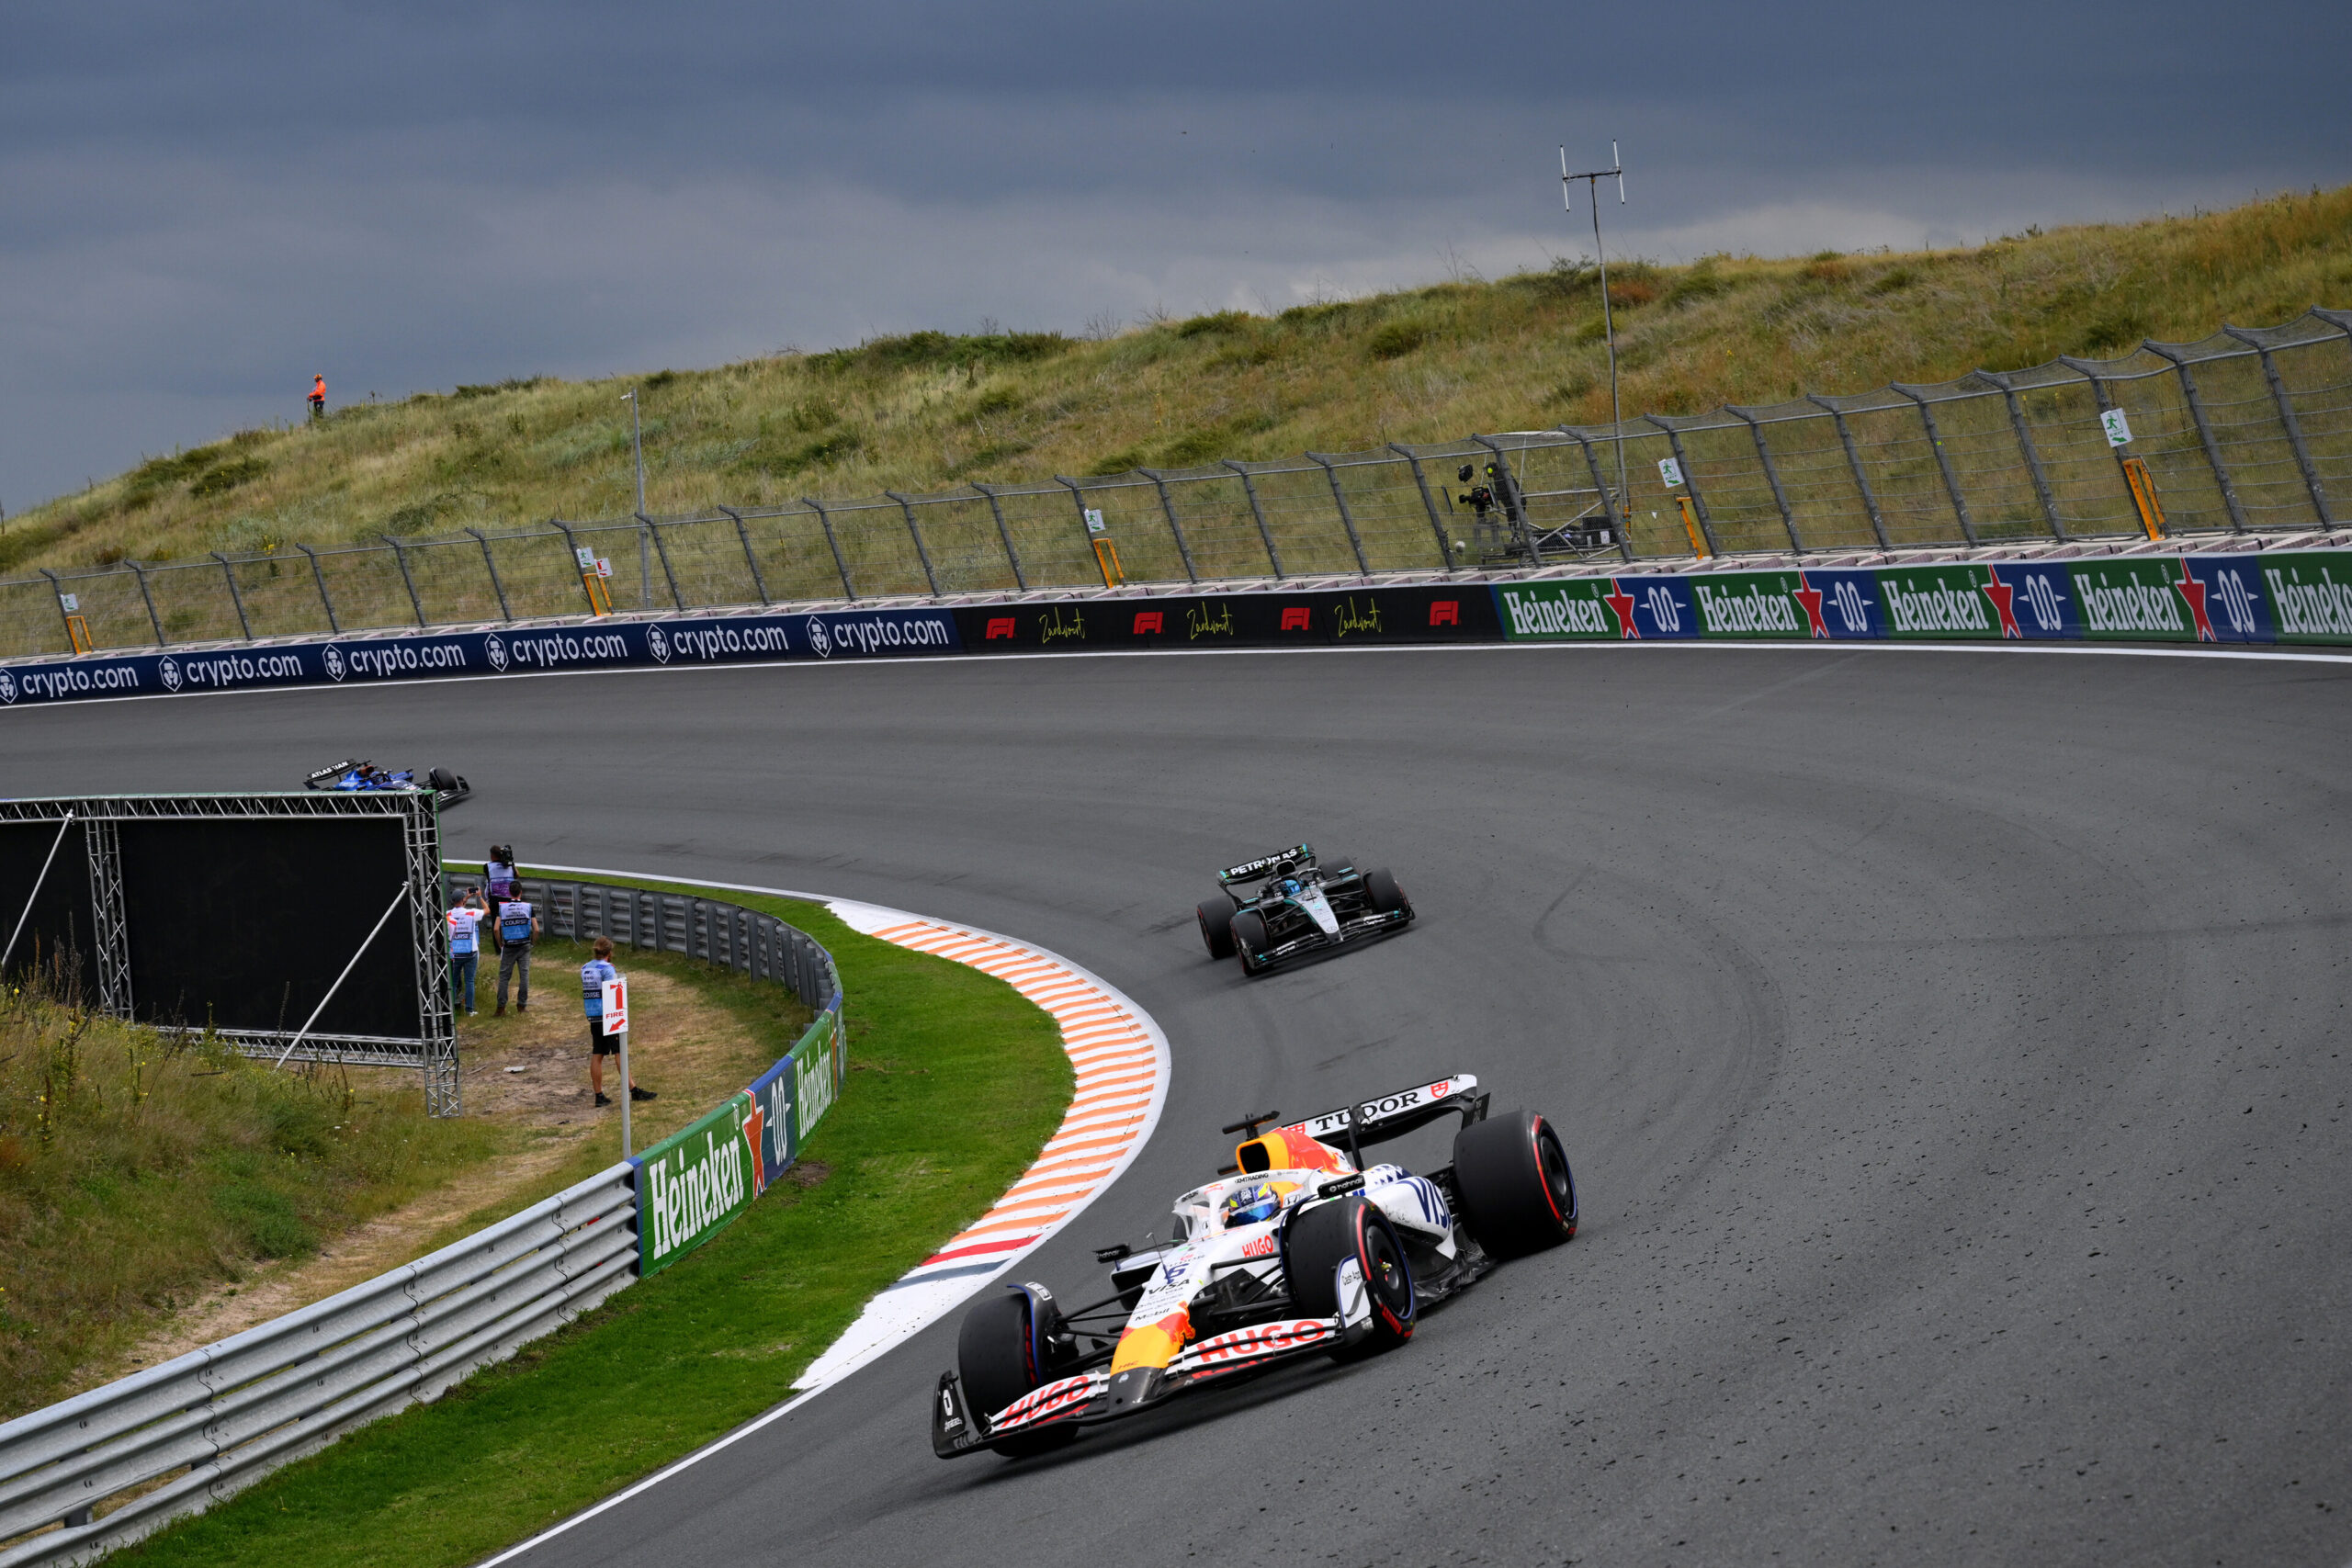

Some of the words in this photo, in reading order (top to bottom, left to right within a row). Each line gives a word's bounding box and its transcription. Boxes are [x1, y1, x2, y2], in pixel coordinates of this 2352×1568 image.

[986, 617, 1016, 639] F1
[1133, 612, 1164, 635] F1
[1281, 607, 1311, 630] F1
[1429, 601, 1459, 626] F1
[1504, 590, 1608, 634] Heineken
[1695, 584, 1798, 632] Heineken
[1882, 578, 1989, 631] Heineken
[2074, 572, 2184, 631] Heineken
[513, 633, 628, 667] crypto.com
[673, 625, 789, 660] crypto.com
[834, 616, 949, 653] crypto.com
[187, 654, 303, 687] crypto.com
[350, 644, 467, 676] crypto.com
[22, 666, 139, 698] crypto.com
[1230, 848, 1298, 875] PETRONAS
[605, 1010, 625, 1019] FIRE
[1316, 1091, 1420, 1132] TUDOR
[649, 1131, 744, 1259] Heineken
[796, 1040, 832, 1140] Heineken
[1396, 1176, 1452, 1231] VIS
[1241, 1235, 1273, 1258] HUGO
[1148, 1279, 1190, 1294] VISA
[1196, 1320, 1326, 1363] HUGO
[1001, 1375, 1090, 1428] HUGO
